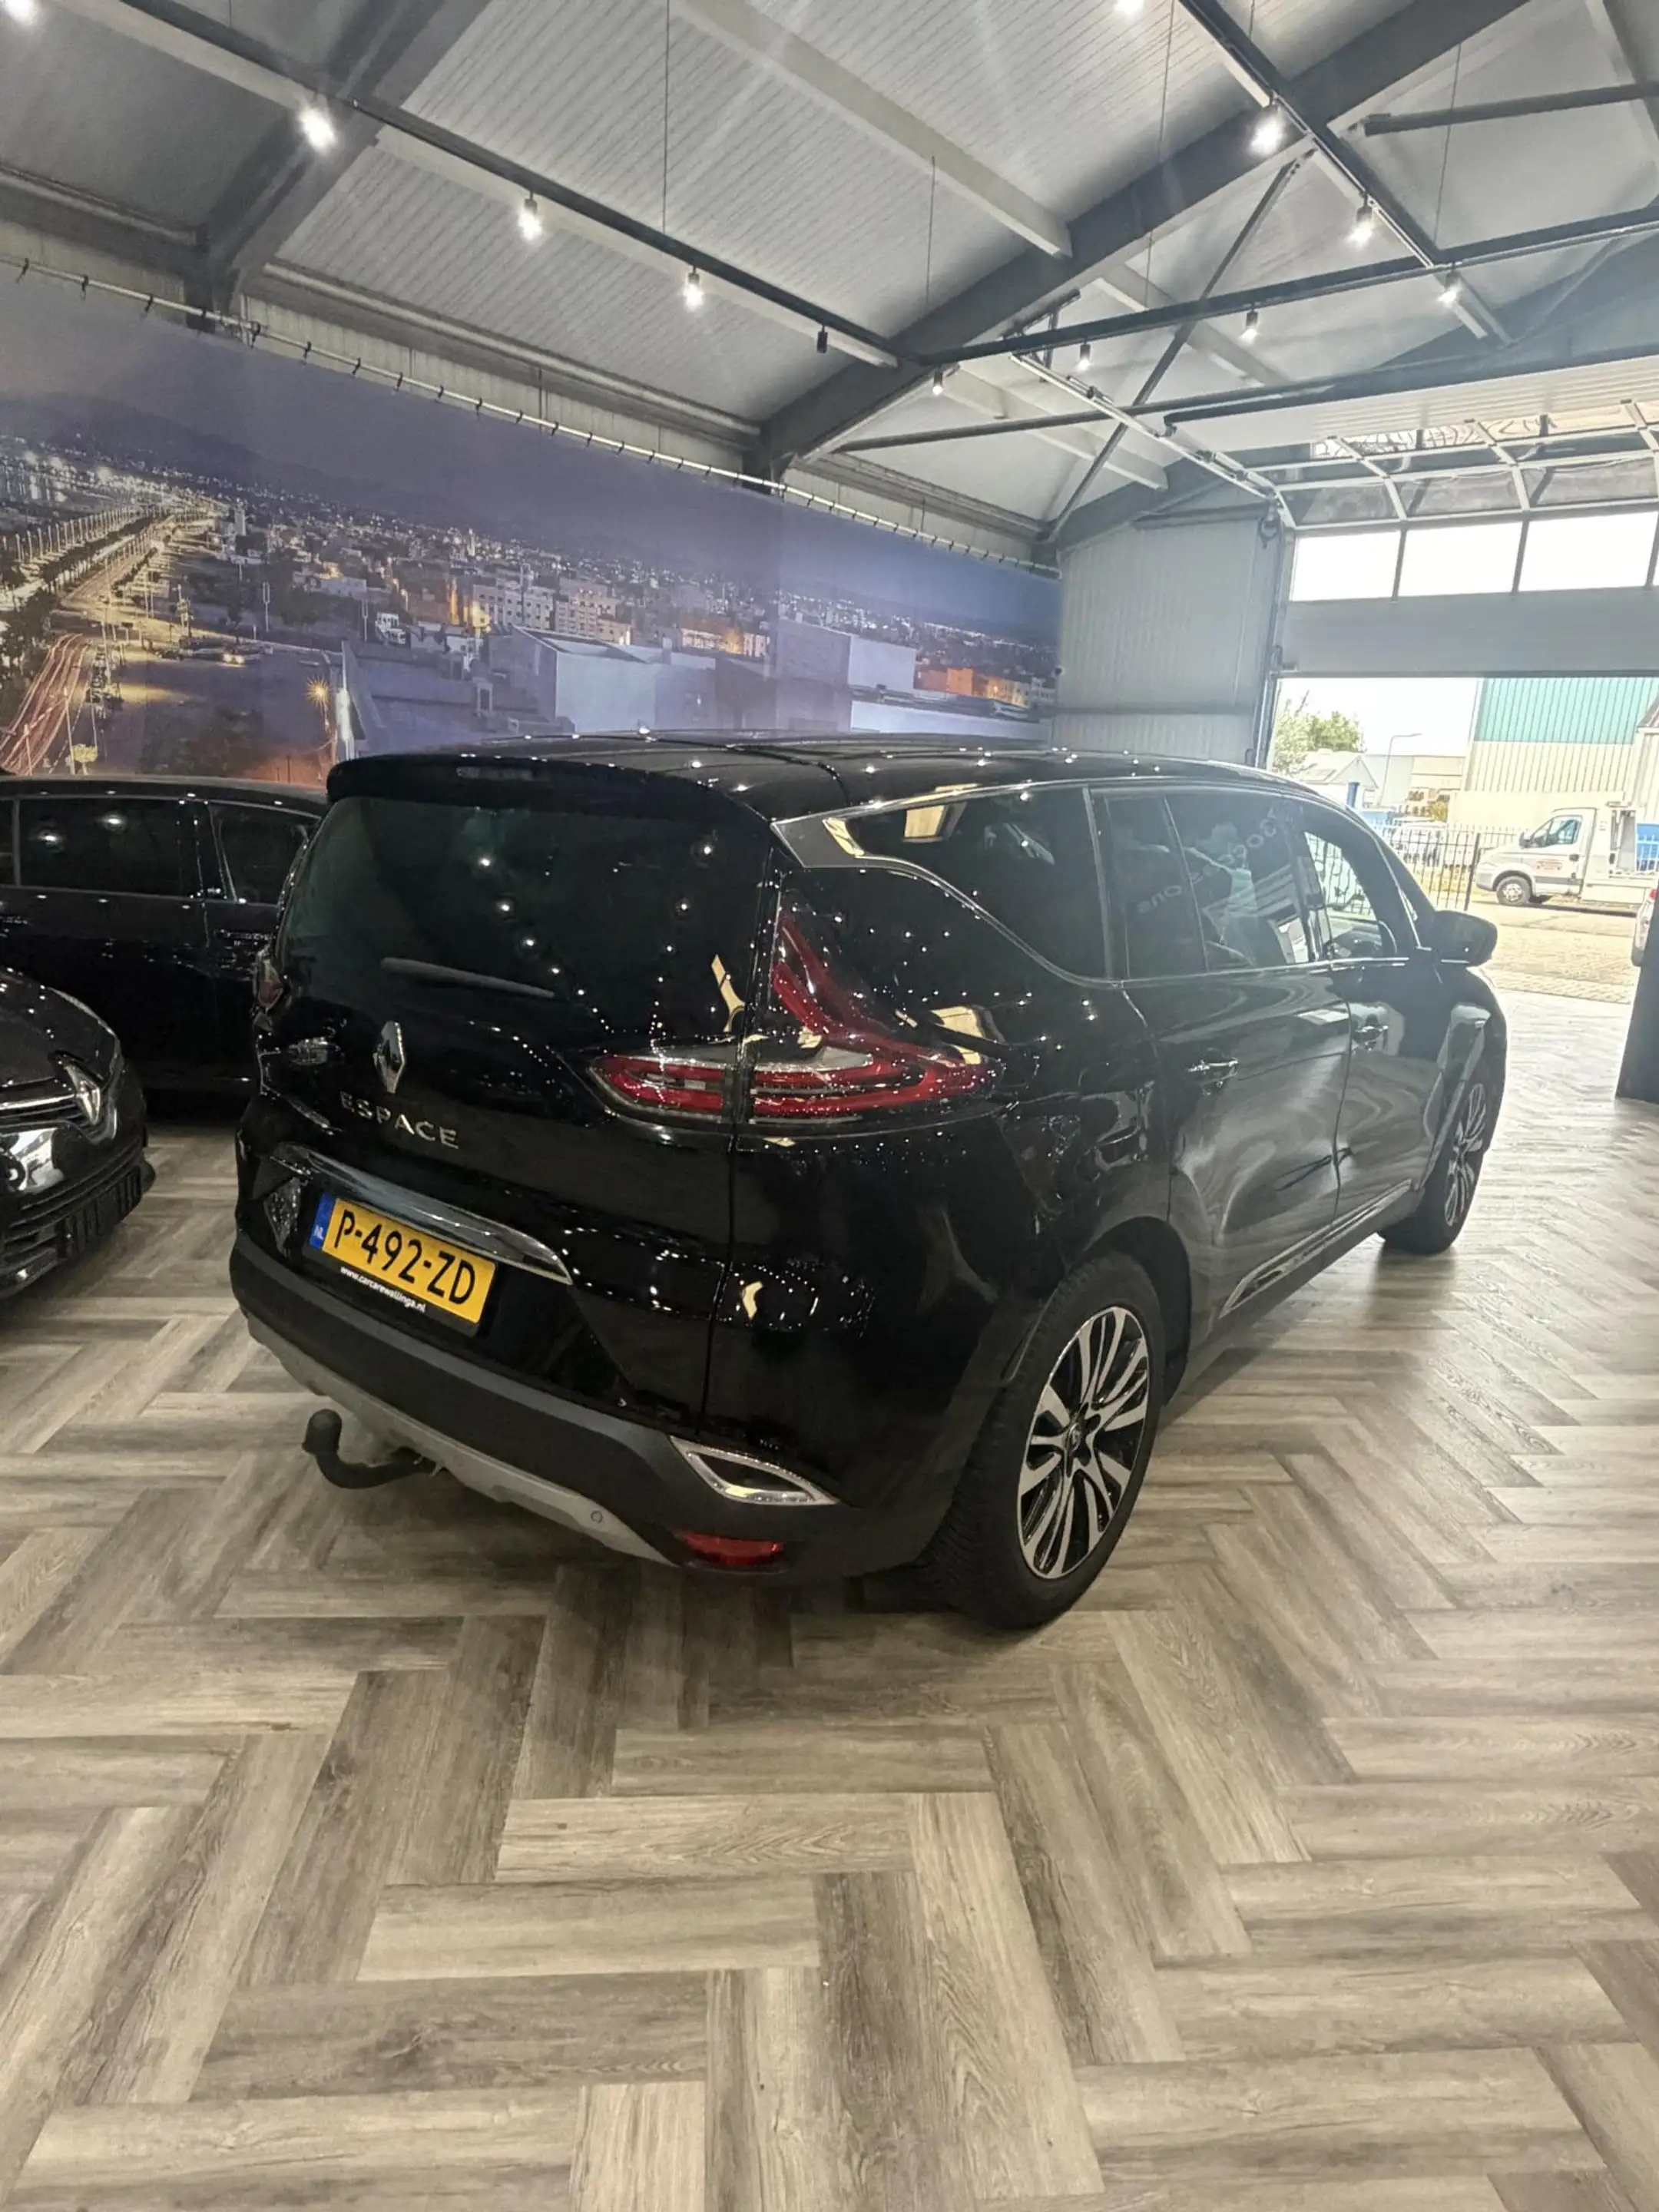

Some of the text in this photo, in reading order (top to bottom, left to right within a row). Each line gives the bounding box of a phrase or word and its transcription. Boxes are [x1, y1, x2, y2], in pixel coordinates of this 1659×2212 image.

[339, 1091, 459, 1150] ESPACE
[313, 1225, 324, 1240] NL
[334, 1209, 475, 1305] P-492-ZD
